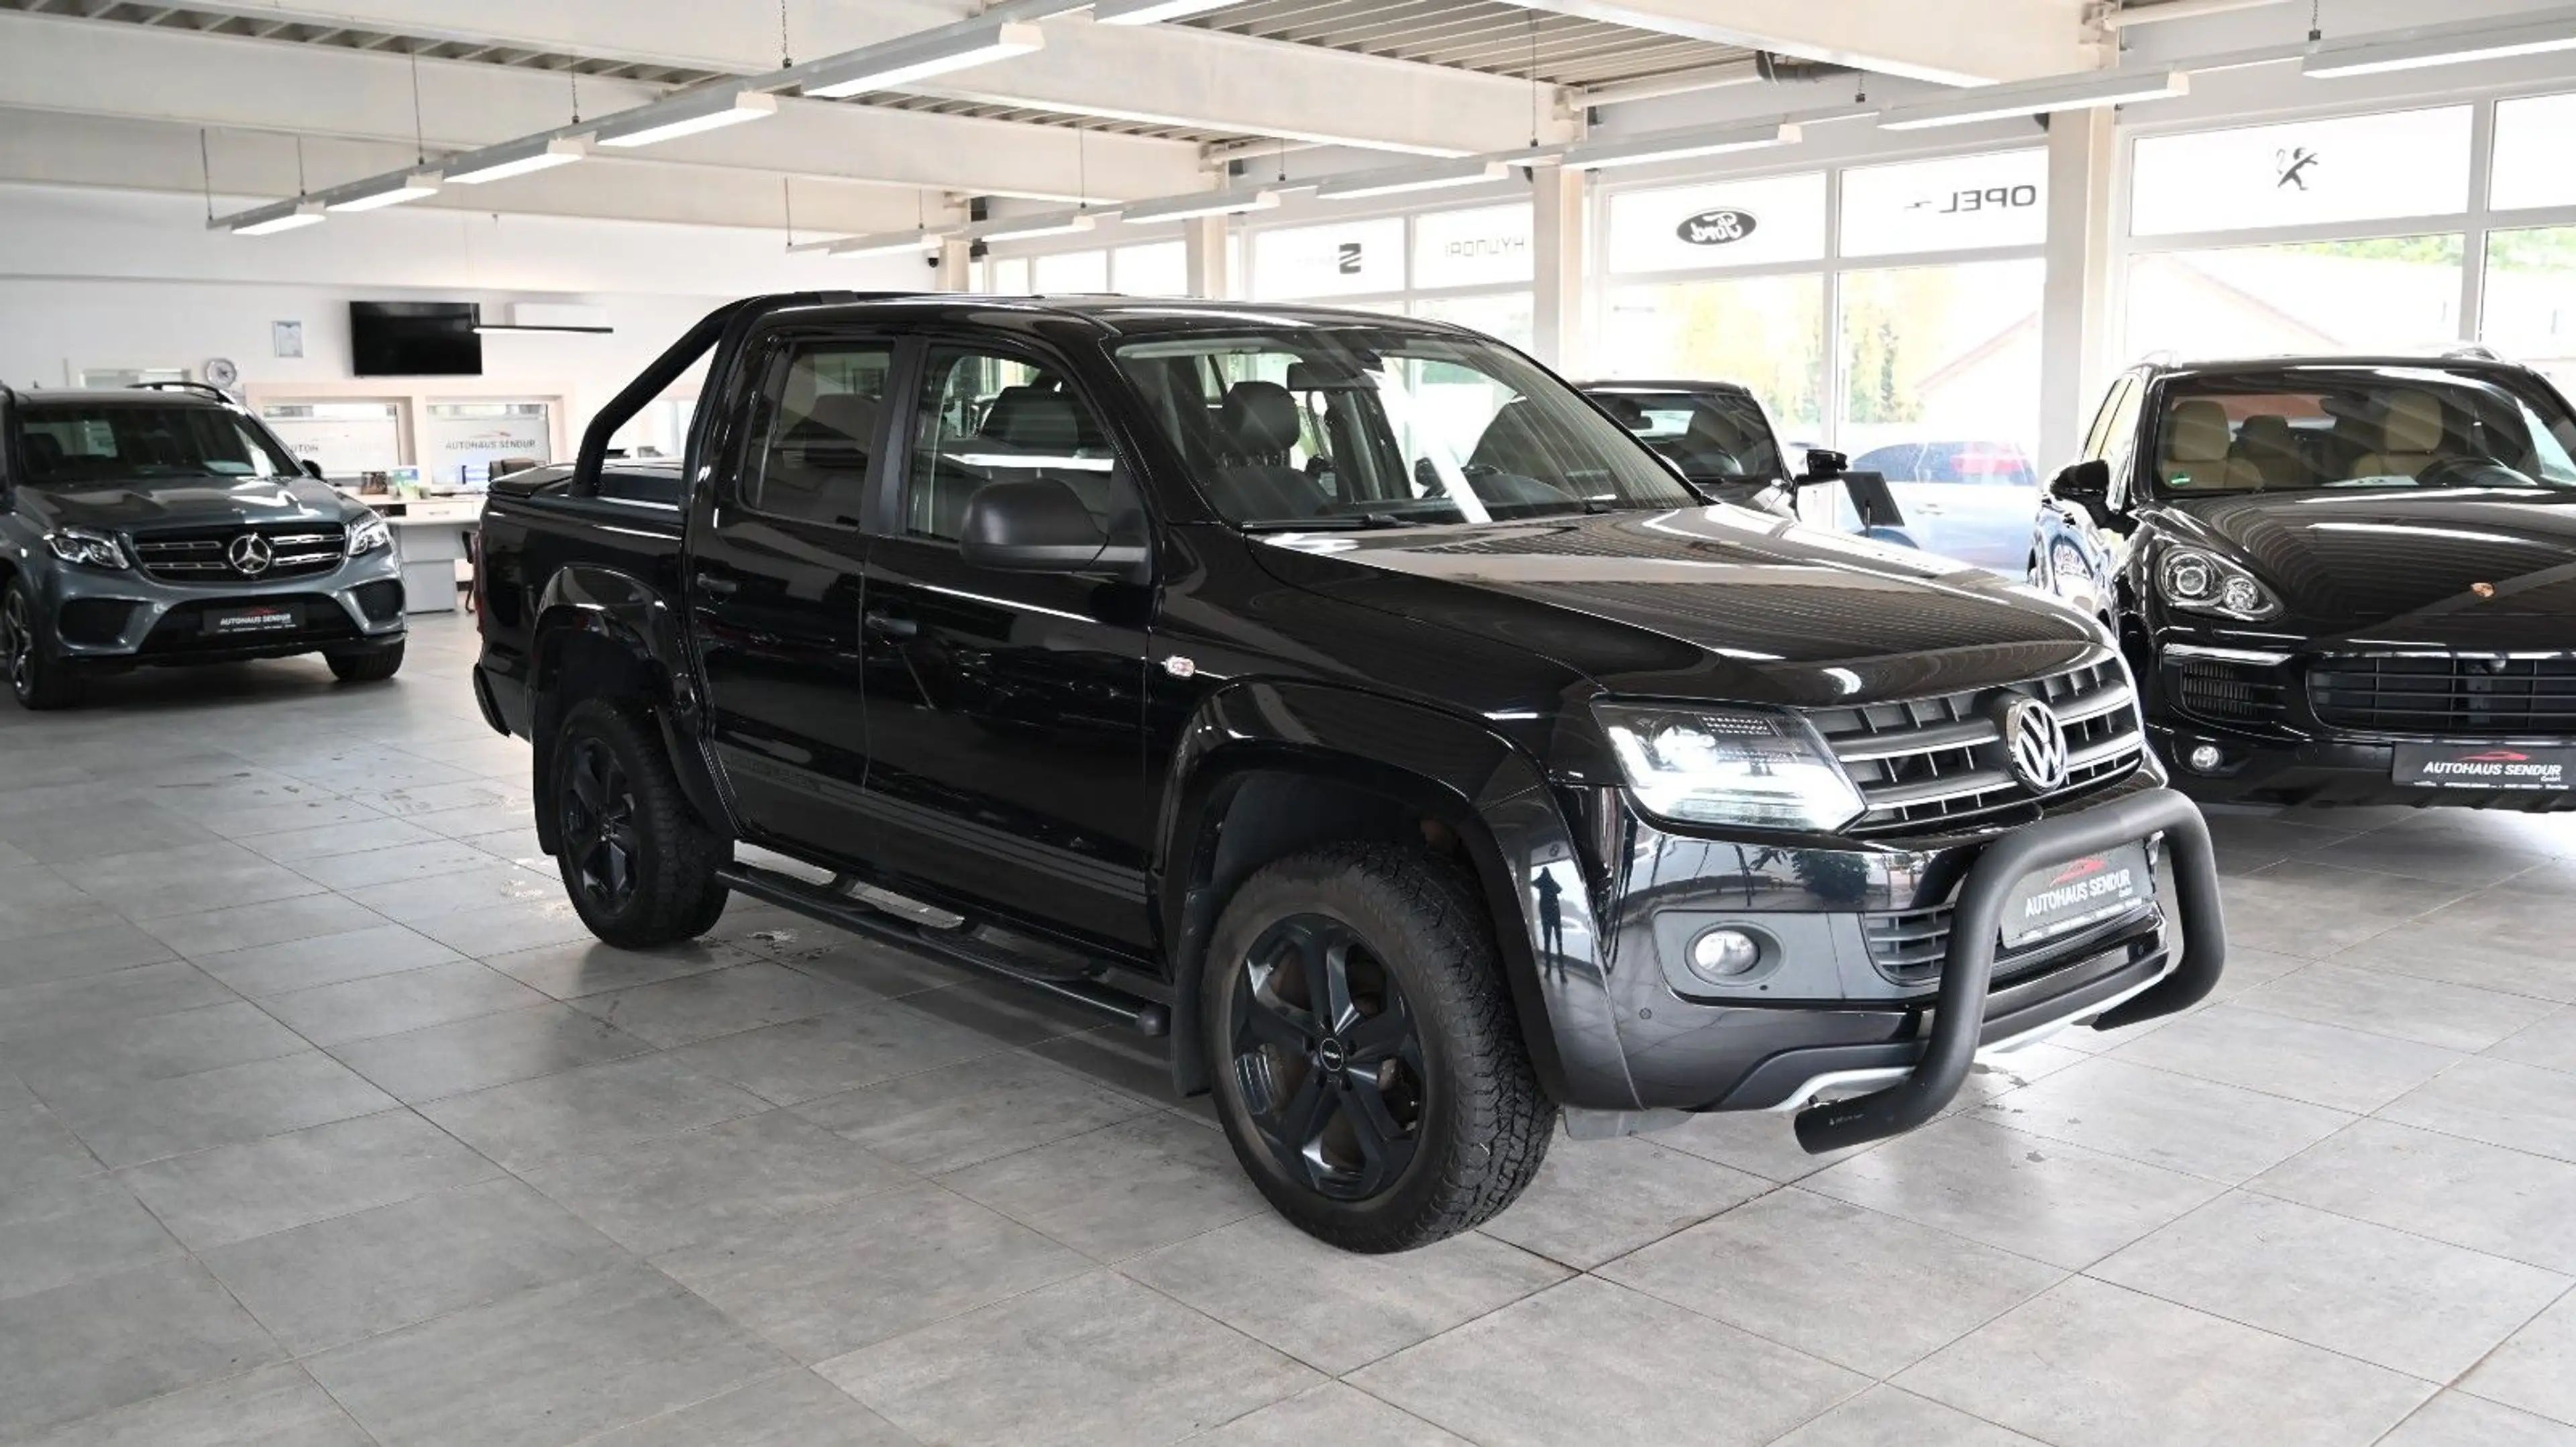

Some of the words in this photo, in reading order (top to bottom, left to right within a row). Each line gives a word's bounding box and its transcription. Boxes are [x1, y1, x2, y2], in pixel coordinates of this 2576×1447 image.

[445, 440, 496, 450] AUTOHAUS
[499, 439, 536, 449] SENDUR
[220, 616, 262, 626] AUTOHAUS
[262, 613, 292, 623] SENDUR
[2422, 761, 2504, 775] AUTOHAUS
[2504, 763, 2563, 777] SENDUR
[2025, 883, 2089, 918] AUTOHAUS
[2088, 869, 2131, 898] SENDUR
